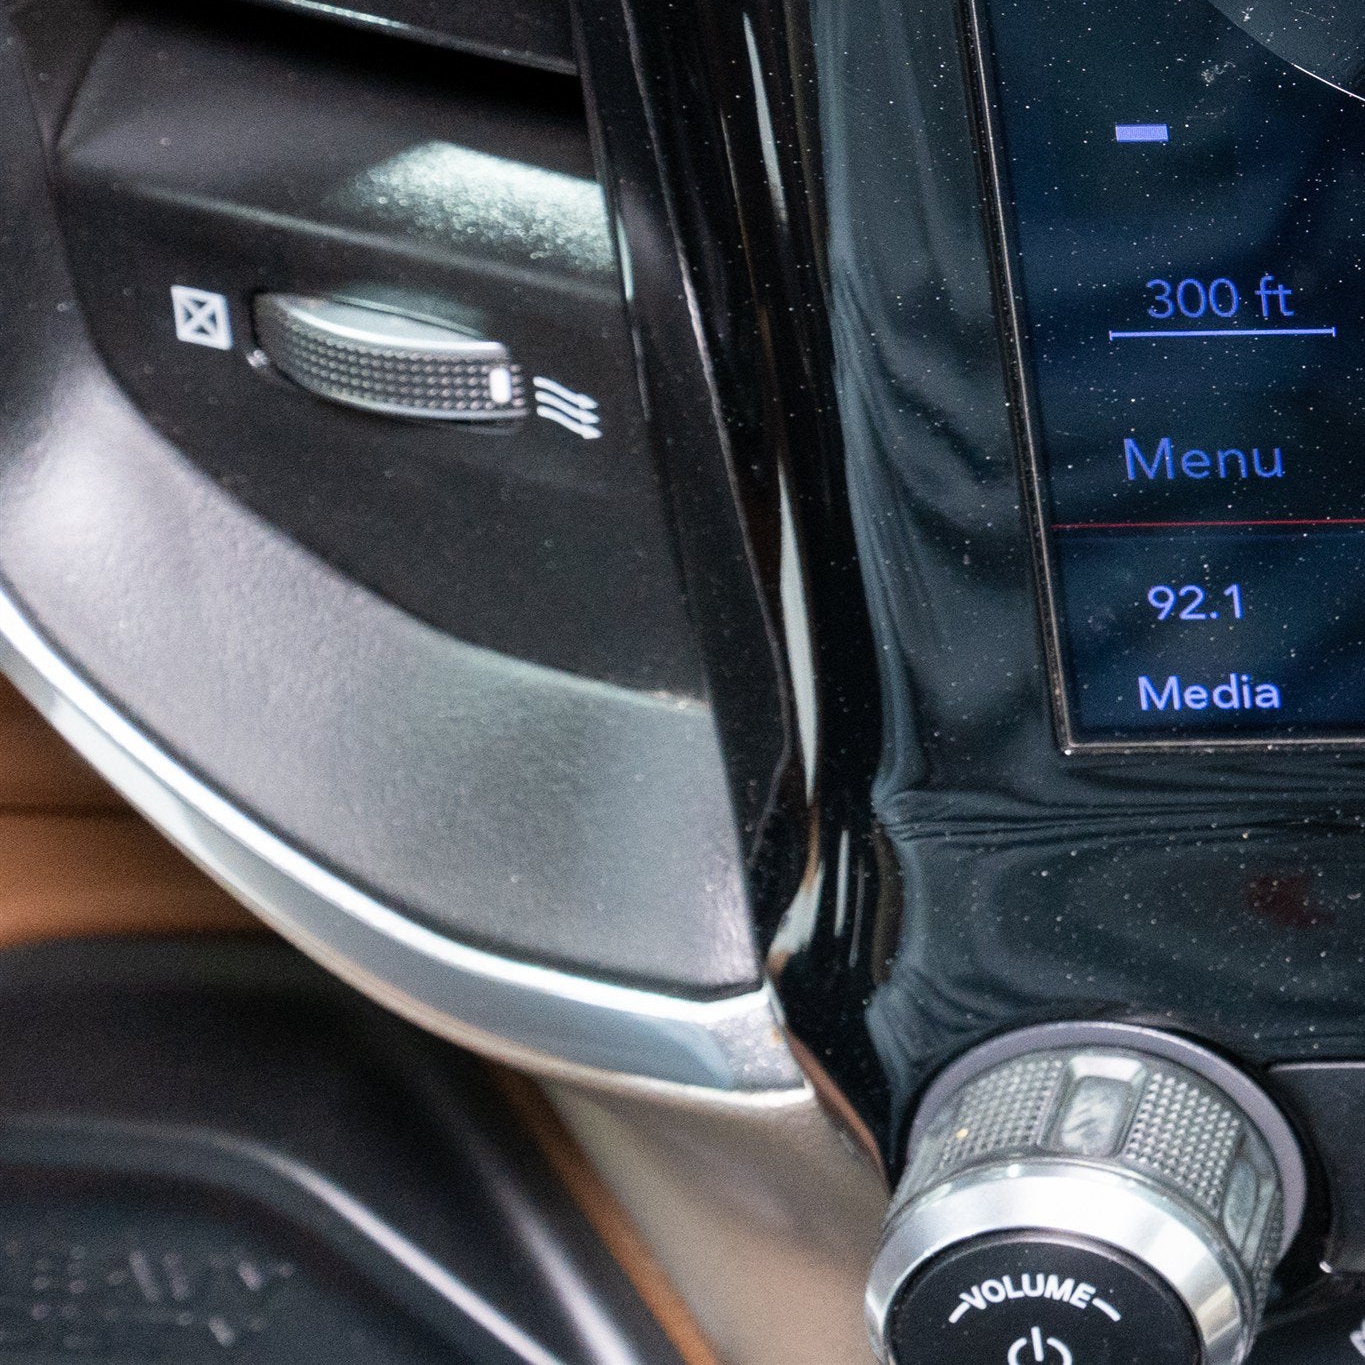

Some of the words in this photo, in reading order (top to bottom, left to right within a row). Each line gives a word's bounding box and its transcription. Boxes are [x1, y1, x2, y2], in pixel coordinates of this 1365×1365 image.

[1145, 278, 1240, 319] 300
[1254, 275, 1295, 317] ft
[1123, 437, 1284, 481] Menu
[1147, 584, 1244, 621] 92.1
[1138, 673, 1282, 711] Media
[959, 1273, 1096, 1310] VOLUME
